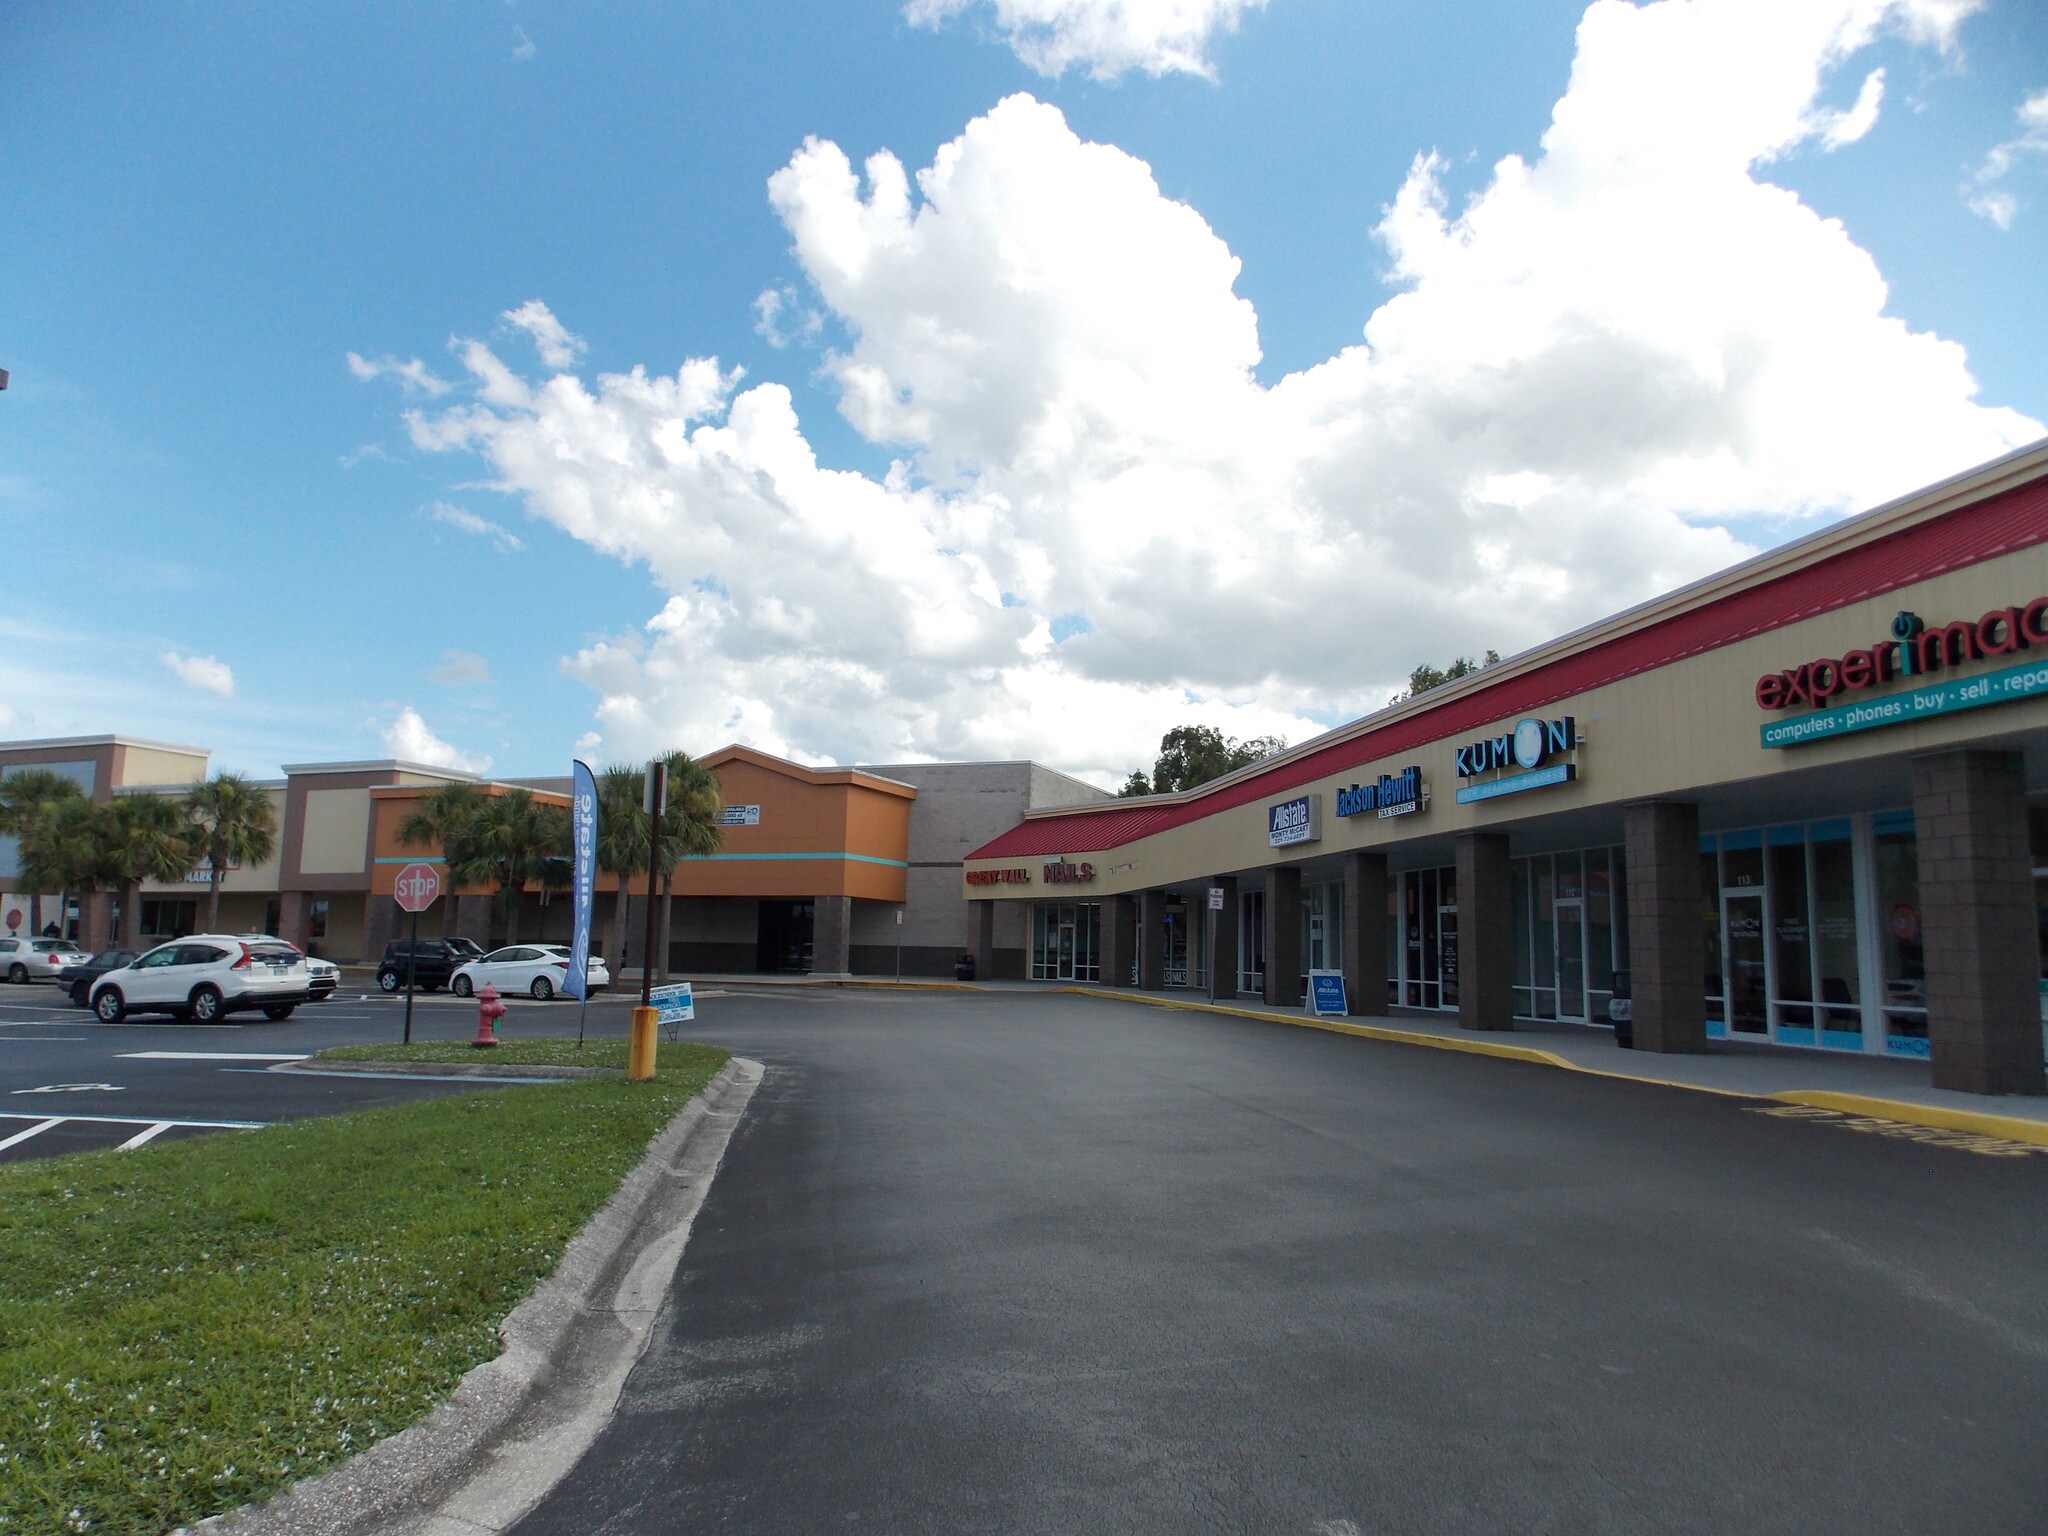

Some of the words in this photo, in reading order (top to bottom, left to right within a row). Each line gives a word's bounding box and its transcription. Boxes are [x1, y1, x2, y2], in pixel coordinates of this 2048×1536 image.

[1765, 716, 1835, 742] computers
[1846, 699, 1901, 728] phones
[1914, 689, 1945, 712] buy
[1960, 679, 1989, 700] sell
[1456, 716, 1570, 778] KUMON
[1336, 784, 1375, 817] Jackson
[1377, 766, 1416, 807] Hewitt
[1273, 801, 1306, 830] Allstate
[1379, 808, 1390, 817] TAX
[1391, 802, 1414, 814] SERVICE
[1000, 868, 1027, 883] WALL
[1043, 862, 1093, 884] NAILS
[399, 878, 436, 897] STOP
